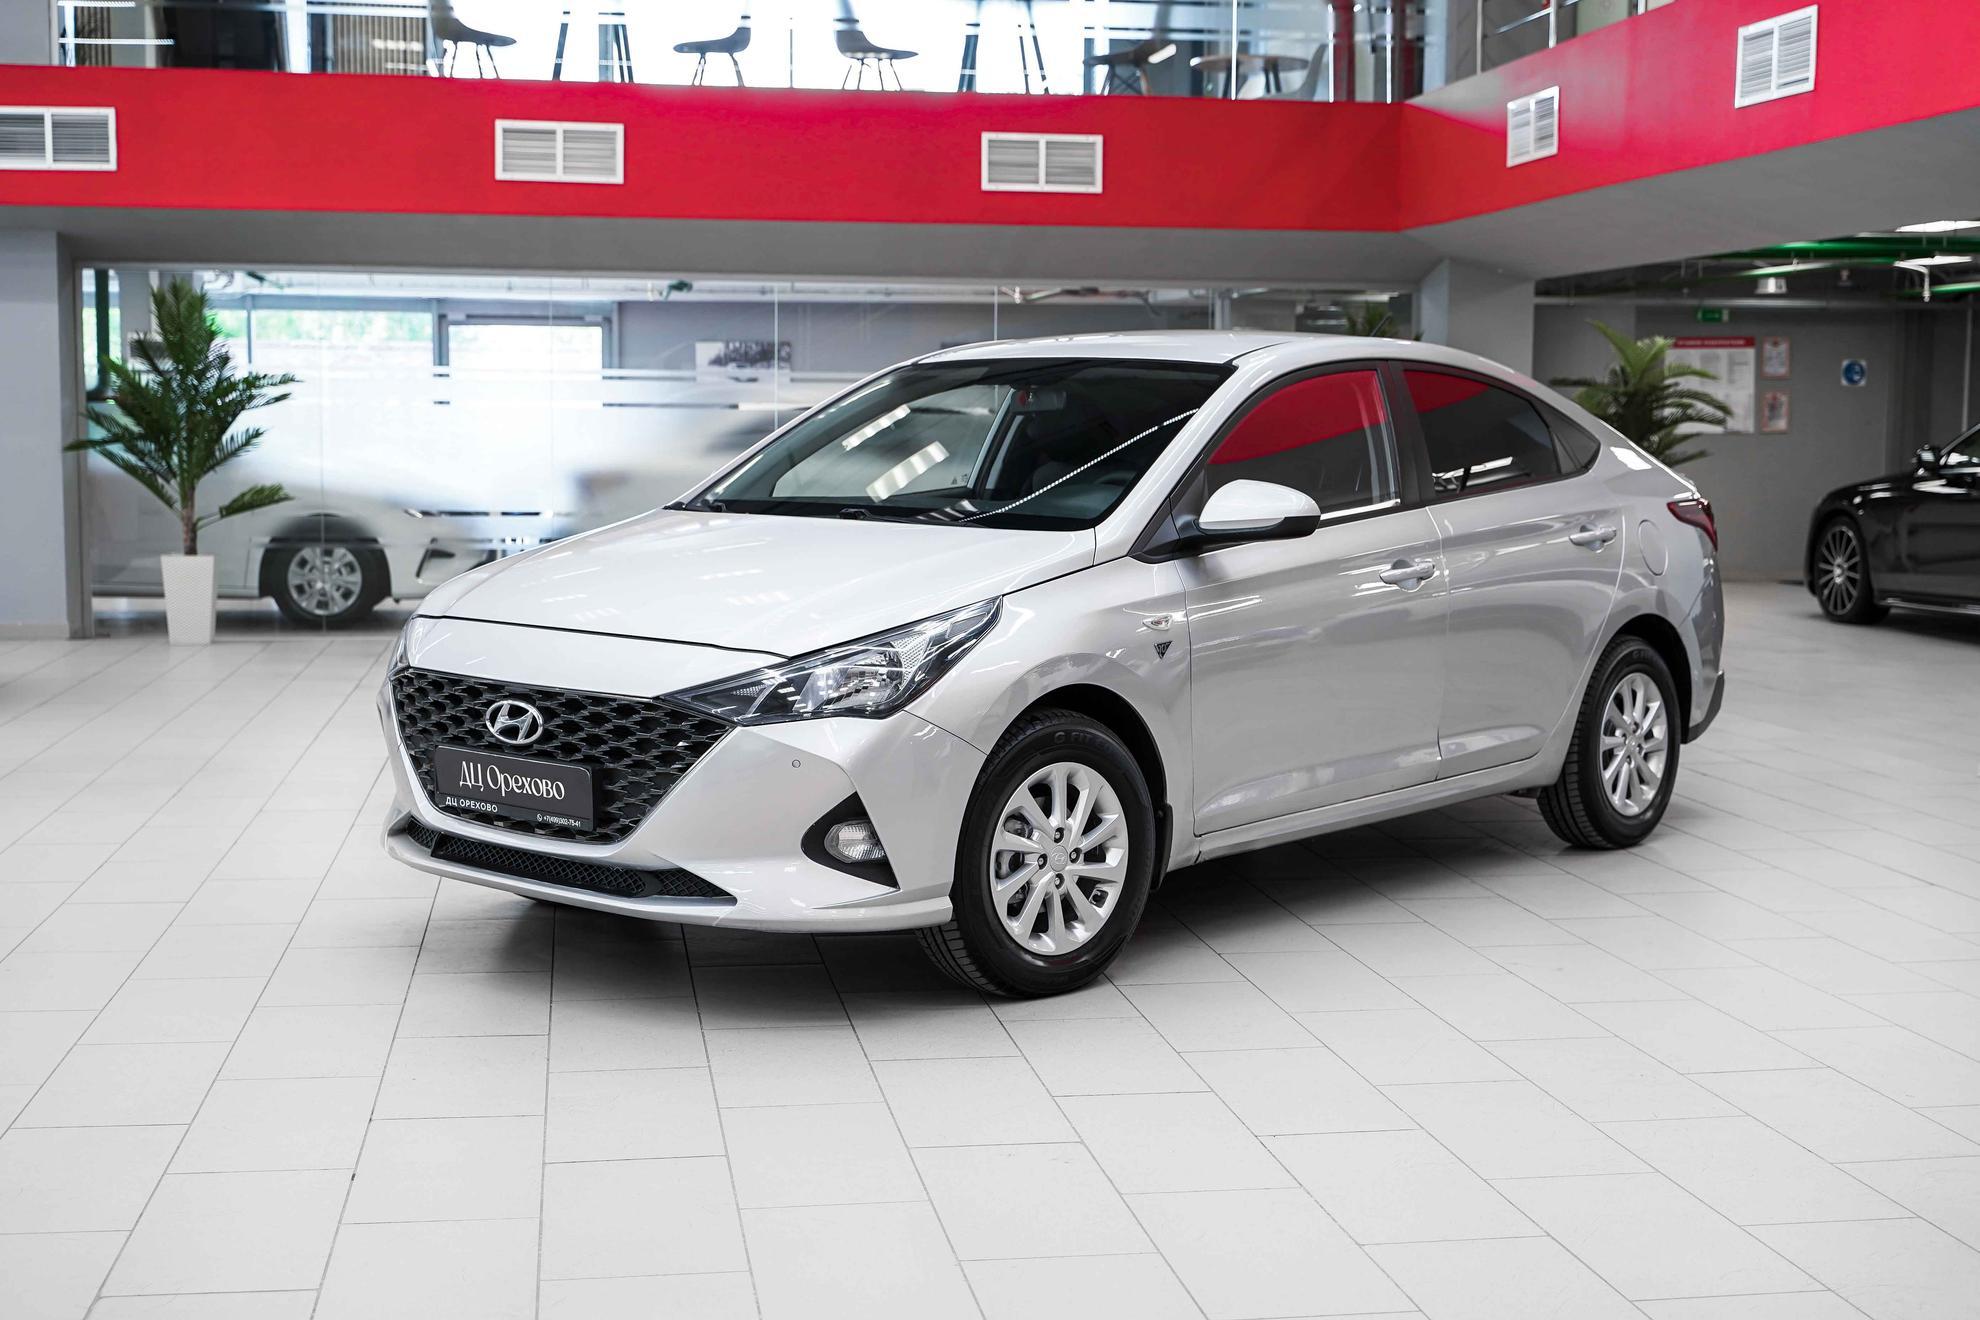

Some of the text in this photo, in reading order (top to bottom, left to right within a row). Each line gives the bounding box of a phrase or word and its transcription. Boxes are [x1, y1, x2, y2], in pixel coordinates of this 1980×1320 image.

[459, 761, 565, 800] ДЦ Орехово
[445, 796, 498, 813] ДЦ ОРЕХОВО
